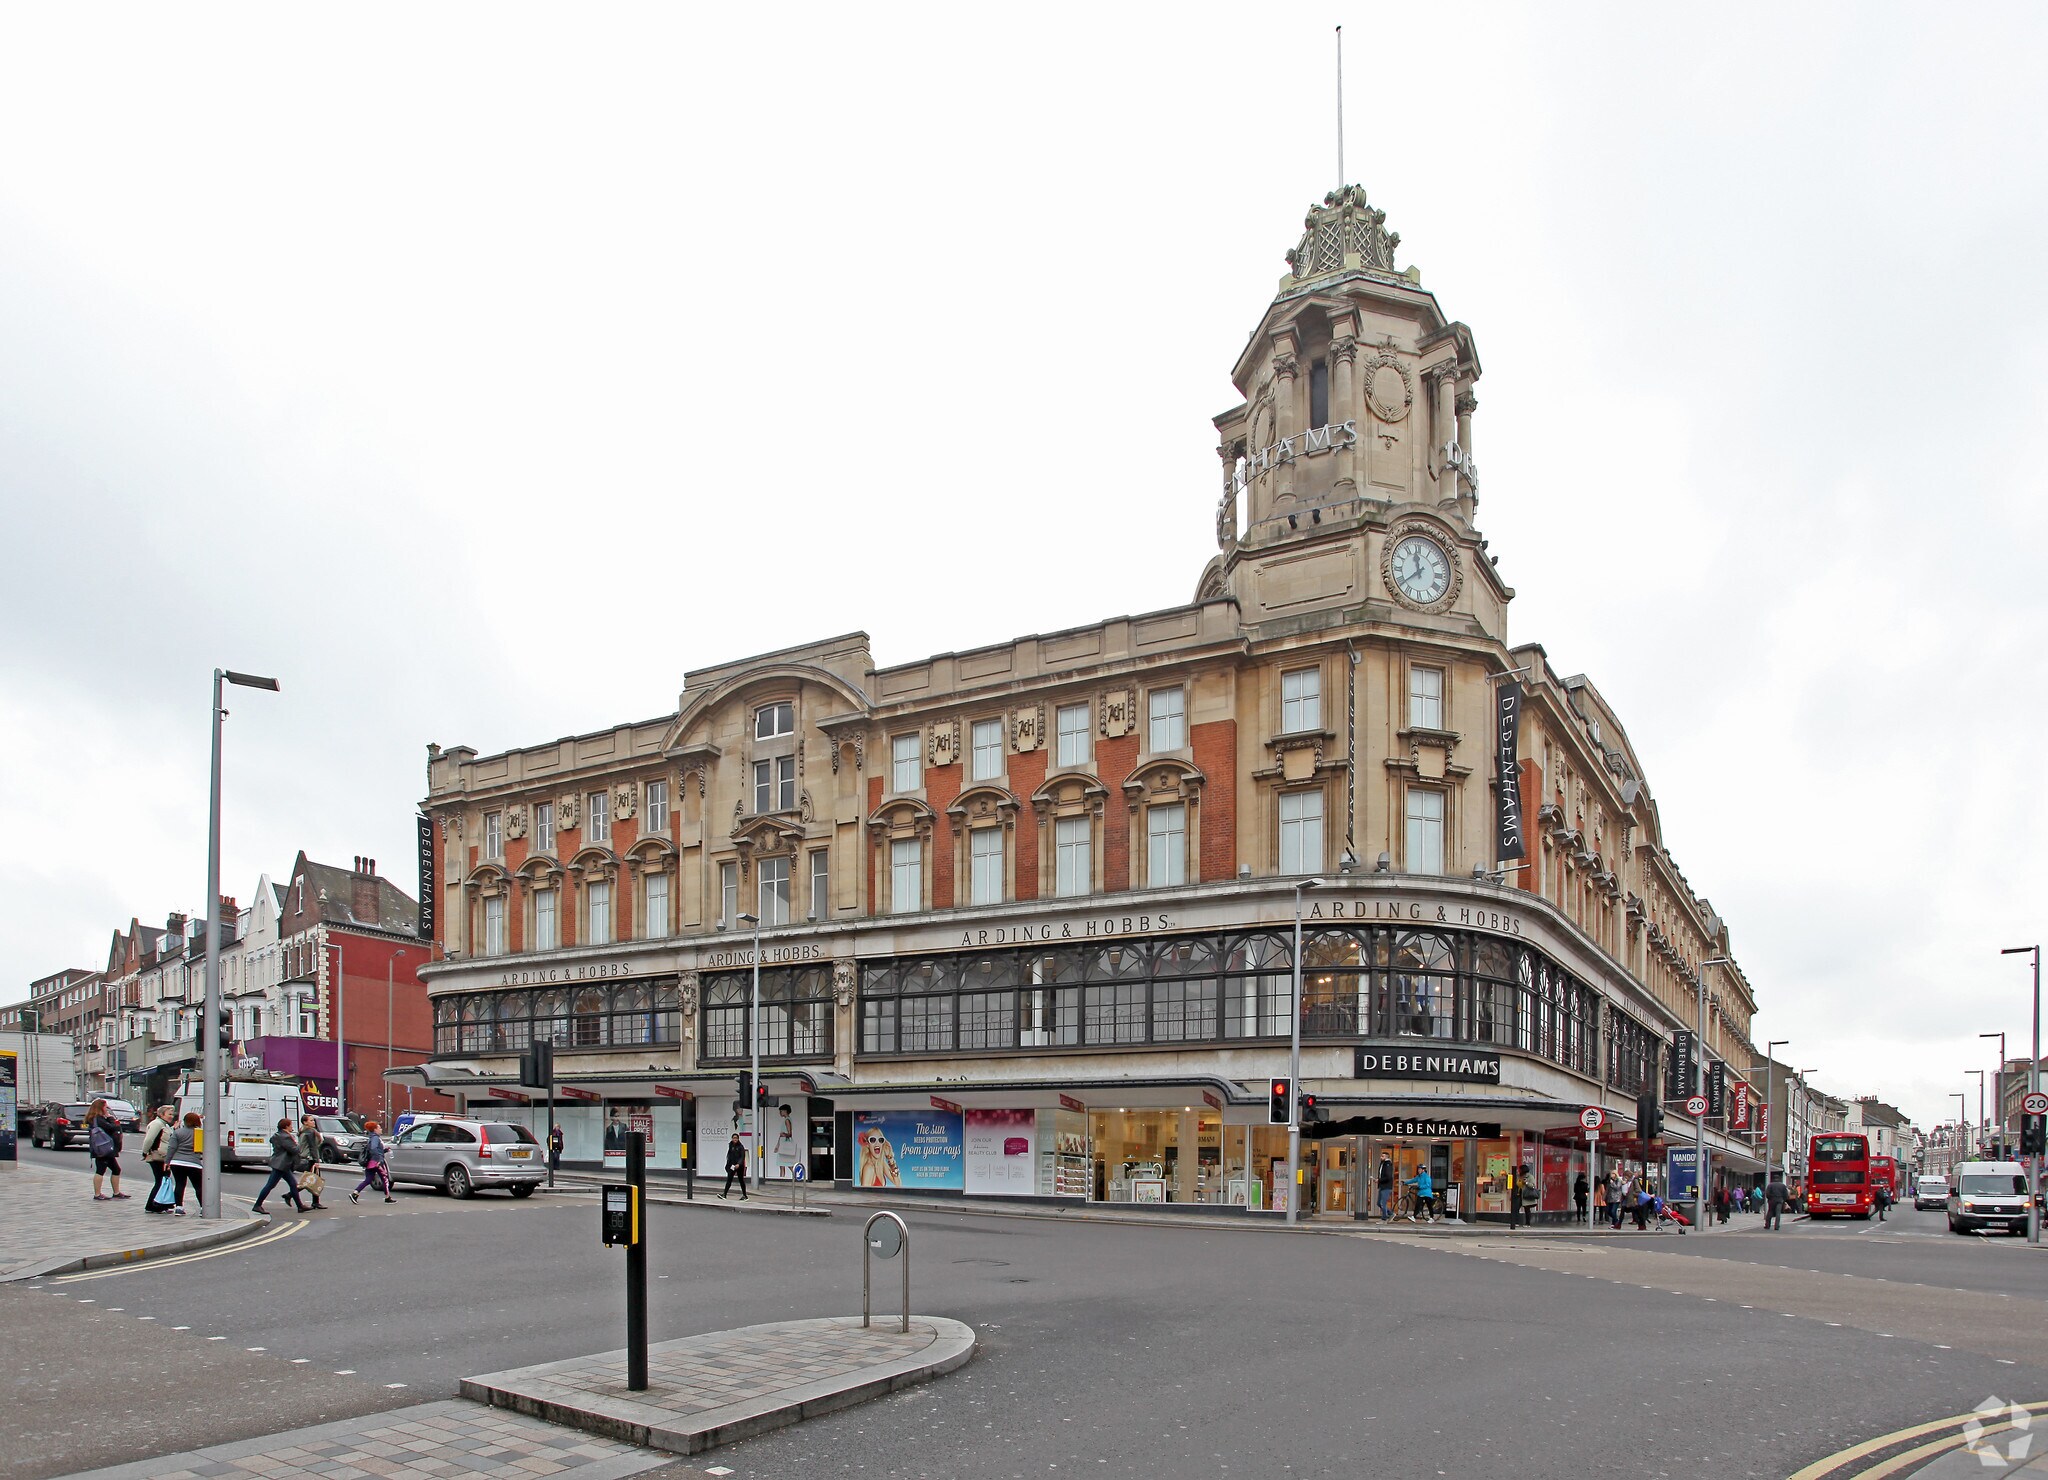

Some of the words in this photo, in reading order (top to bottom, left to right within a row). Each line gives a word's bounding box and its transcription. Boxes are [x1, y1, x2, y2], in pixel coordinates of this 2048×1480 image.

[422, 827, 432, 929] DEBENHAMS
[1310, 902, 1420, 919] ARDING
[1436, 906, 1446, 922] &
[1460, 908, 1520, 934] HOBBS
[962, 924, 1050, 946] ARDING
[1062, 923, 1072, 938] &
[1086, 914, 1168, 936] HOBBS
[708, 950, 754, 966] ARDING
[760, 950, 768, 962] &
[774, 944, 820, 962] HOBBS
[502, 970, 556, 986] ARDING
[564, 968, 570, 980] &
[578, 962, 629, 979] HOBBS
[1364, 1054, 1499, 1076] DEBENHAMS
[1678, 1036, 1686, 1095] DEBENHAMS
[1688, 1102, 1704, 1110] 20
[2027, 1100, 2046, 1108] 20
[916, 1122, 930, 1134] The
[930, 1125, 946, 1134] sun
[1384, 1122, 1478, 1136] DEBENHAMS
[900, 1142, 922, 1159] from
[922, 1146, 942, 1160] your
[942, 1144, 961, 1160] rays
